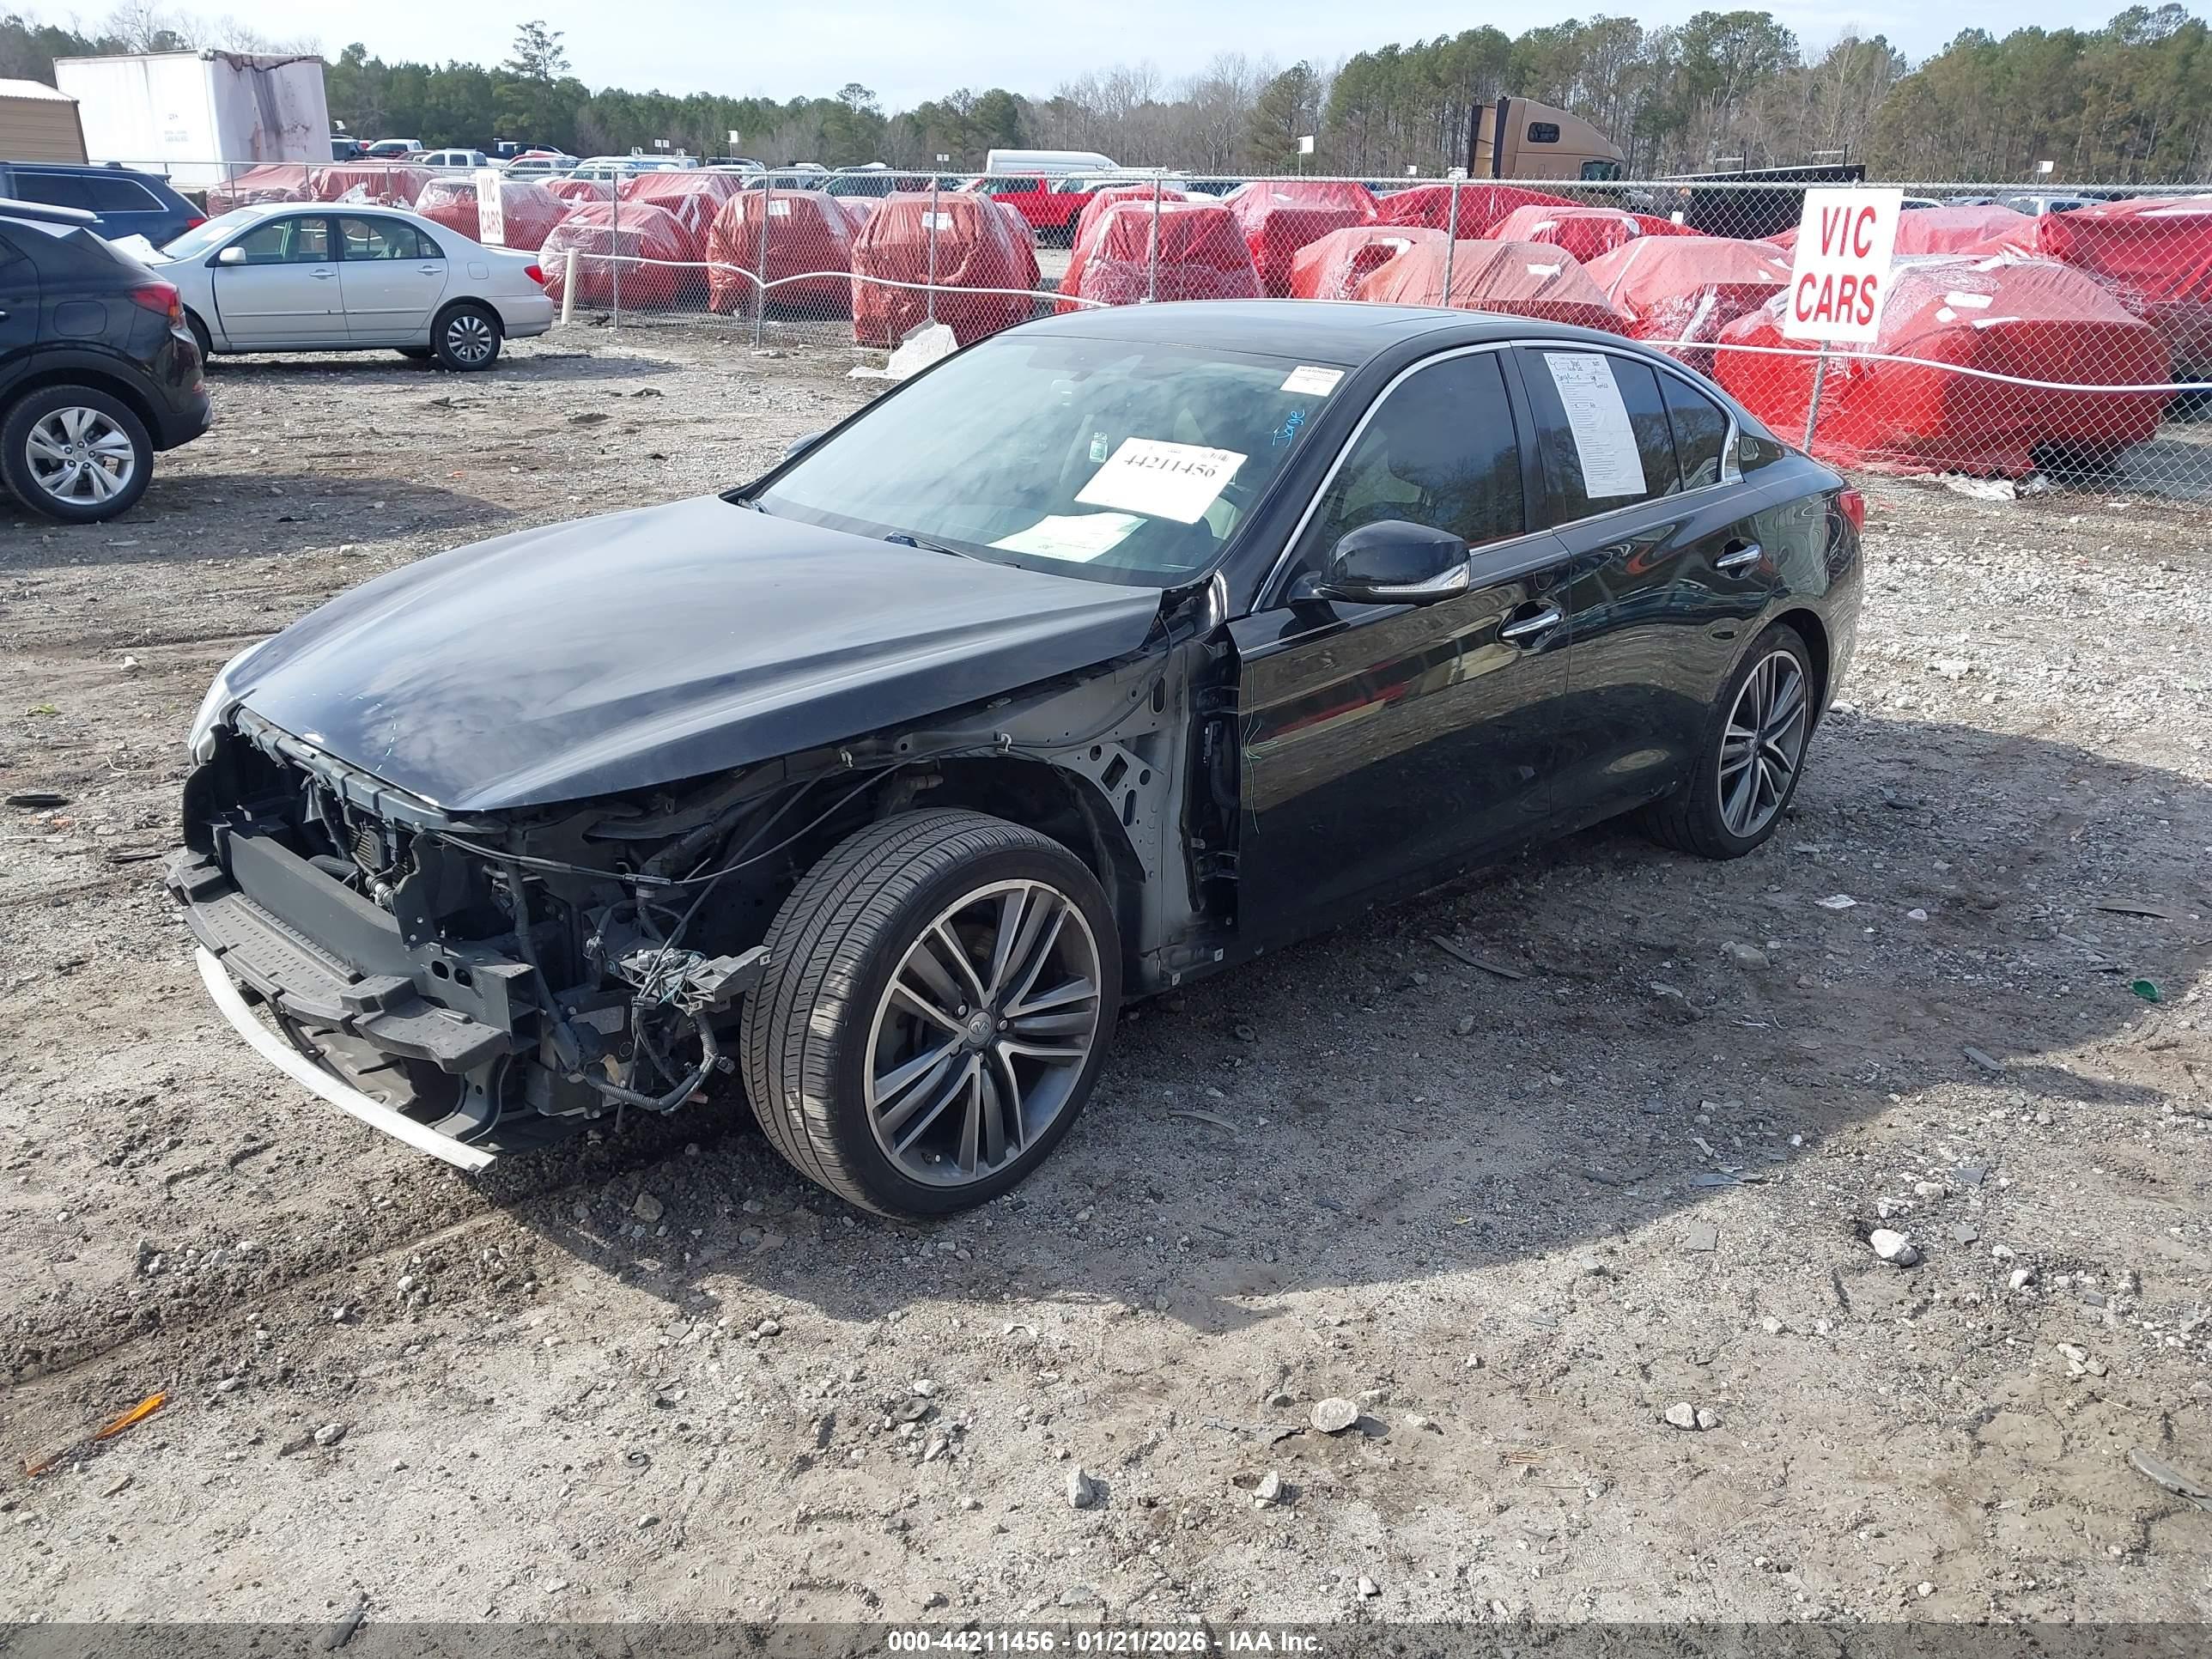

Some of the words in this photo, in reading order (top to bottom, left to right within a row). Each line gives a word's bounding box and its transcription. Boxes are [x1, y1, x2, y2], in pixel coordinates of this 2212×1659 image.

[480, 177, 495, 203] VIC
[481, 210, 501, 235] CARS
[1821, 205, 1877, 258] VIC
[1796, 272, 1878, 326] CARS
